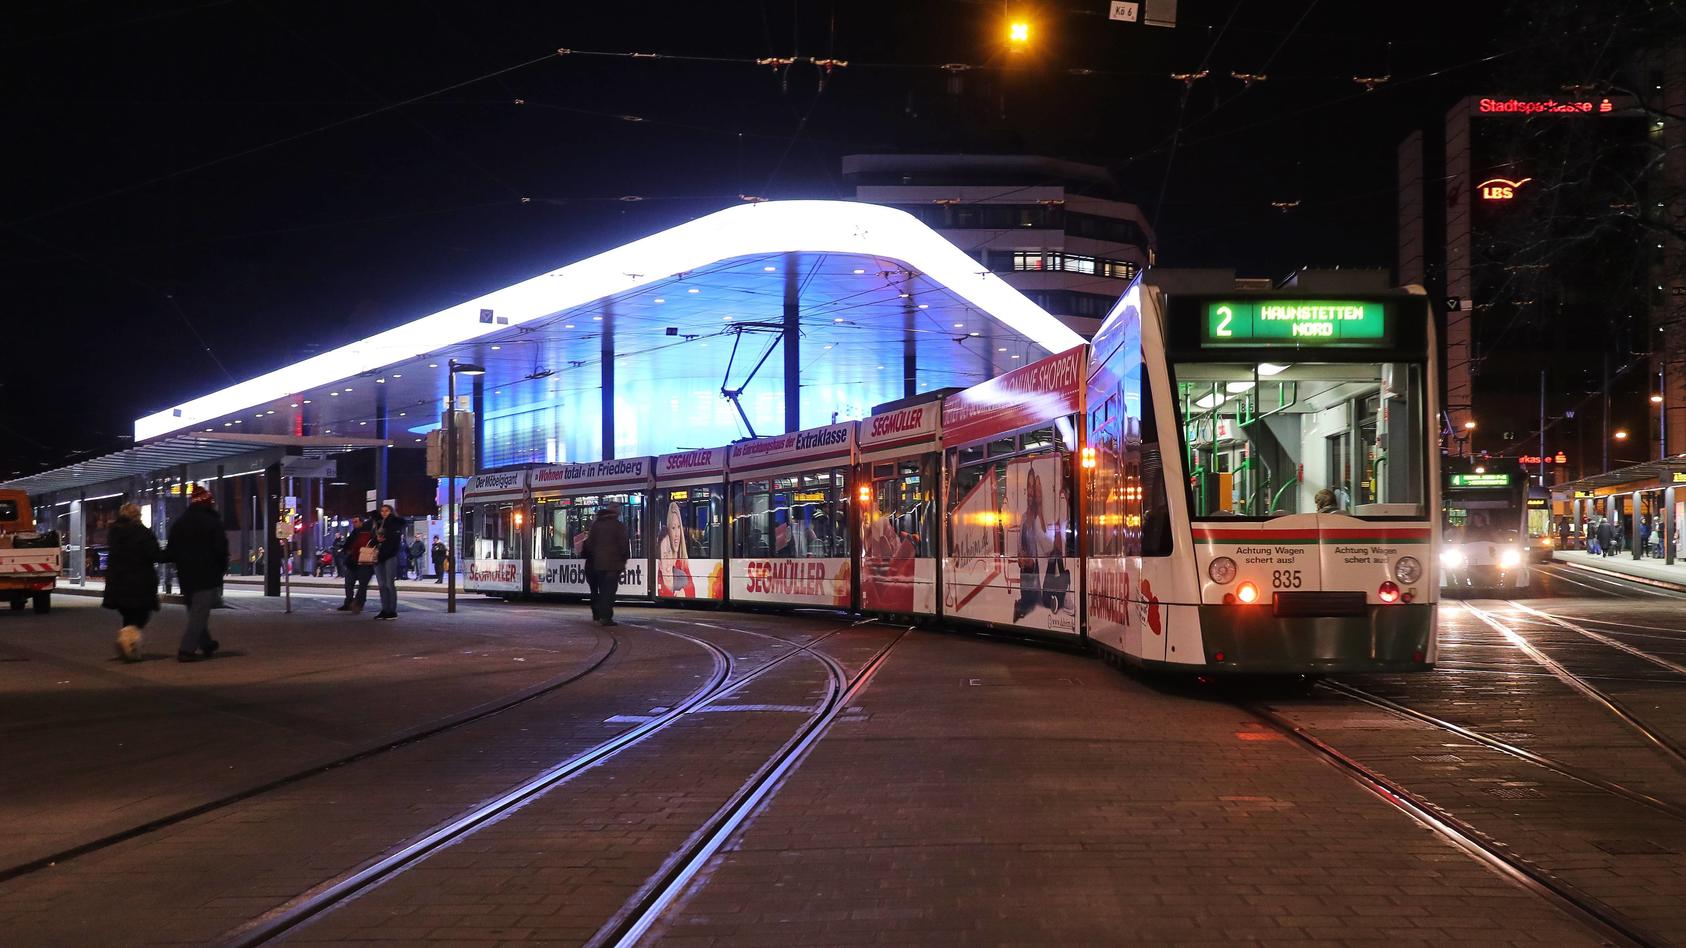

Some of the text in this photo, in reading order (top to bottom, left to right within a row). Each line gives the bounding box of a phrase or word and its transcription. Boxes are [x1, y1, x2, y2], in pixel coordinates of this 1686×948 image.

[1483, 187, 1513, 199] LBS
[1216, 305, 1233, 337] 2
[1260, 305, 1364, 321] HAUNSTETTEN
[1291, 322, 1334, 337] NORD
[1037, 353, 1080, 392] SHOPPEN
[785, 435, 796, 449] der
[795, 428, 848, 450] Extraklasse
[586, 466, 596, 477] in
[596, 461, 643, 477] Friedberg
[1236, 546, 1305, 555] Achtung Wagen
[1334, 546, 1398, 556] Achtung Wagen
[1245, 556, 1296, 564] schert aus!
[1344, 556, 1371, 564] schert
[746, 559, 826, 596] SEGMÜLLER
[1272, 570, 1302, 589] 835
